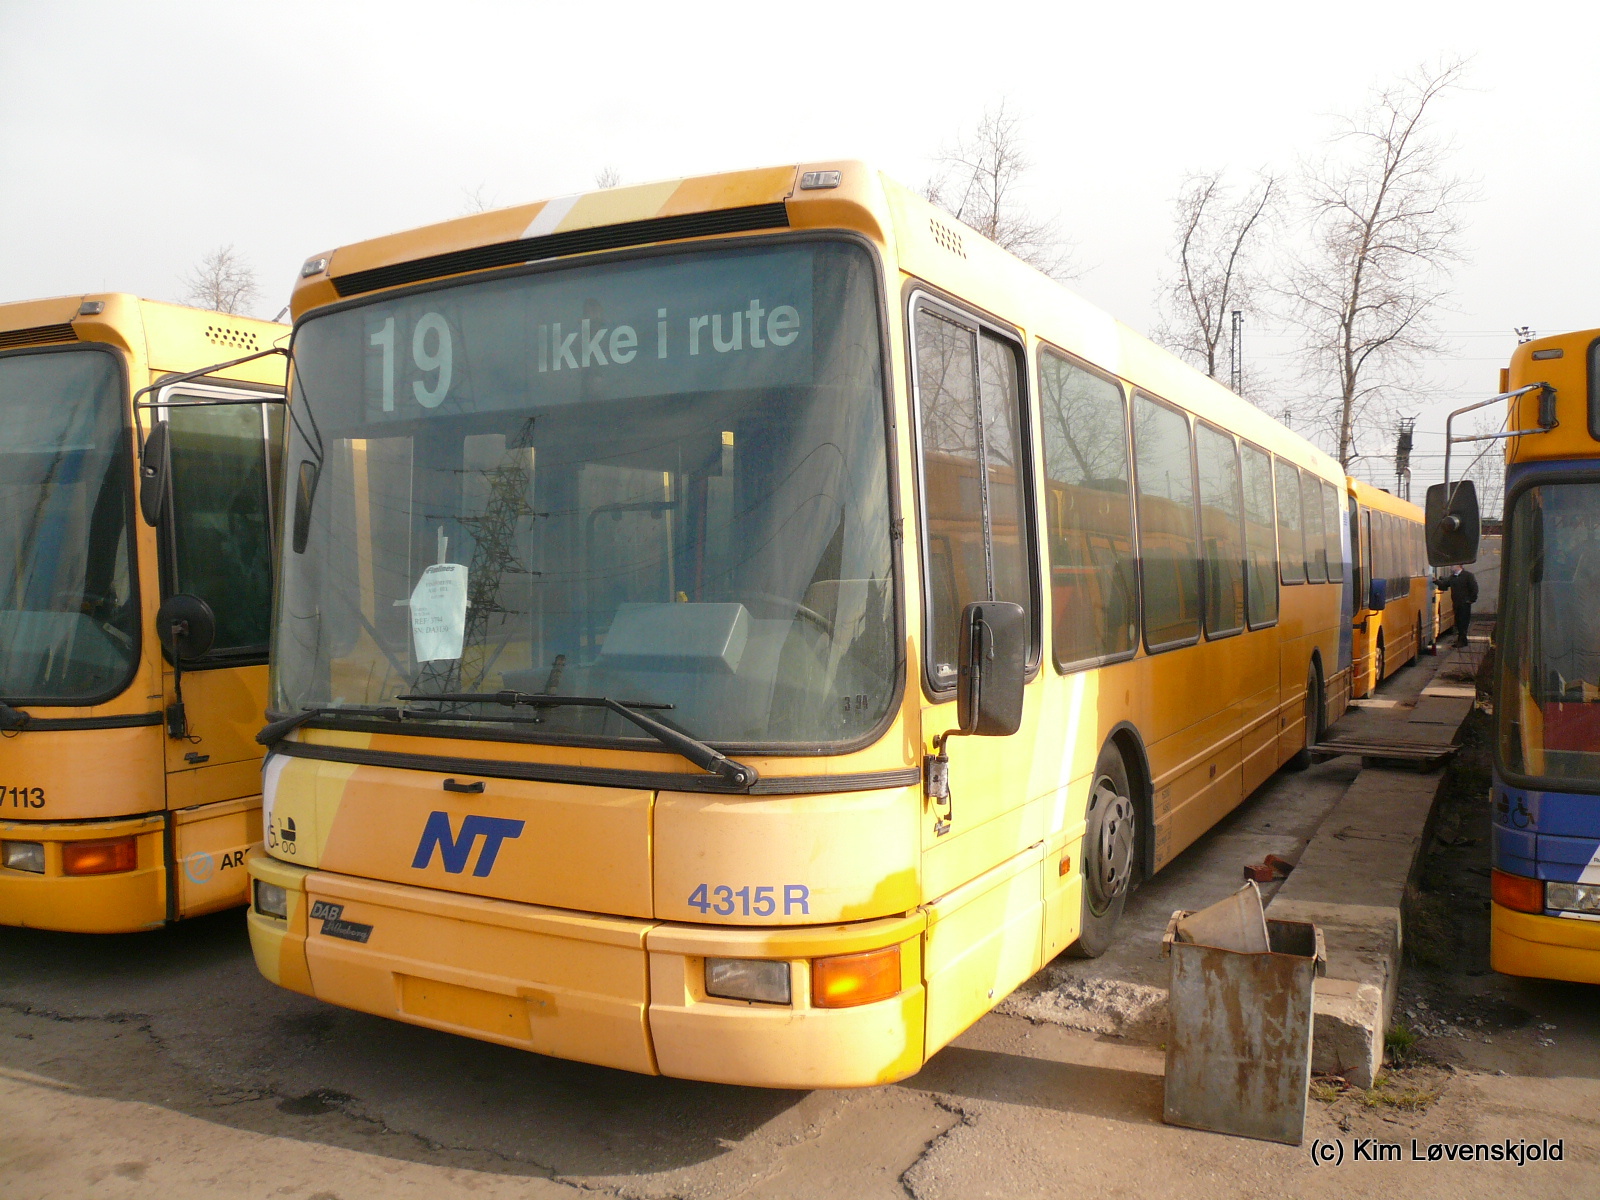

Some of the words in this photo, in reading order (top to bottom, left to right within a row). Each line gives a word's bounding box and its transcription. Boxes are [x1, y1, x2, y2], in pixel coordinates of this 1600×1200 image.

[370, 312, 453, 412] 19
[538, 318, 638, 373] Ikke
[657, 307, 668, 360] i
[689, 299, 800, 356] rute
[411, 811, 526, 878] NT
[312, 903, 340, 920] DAB
